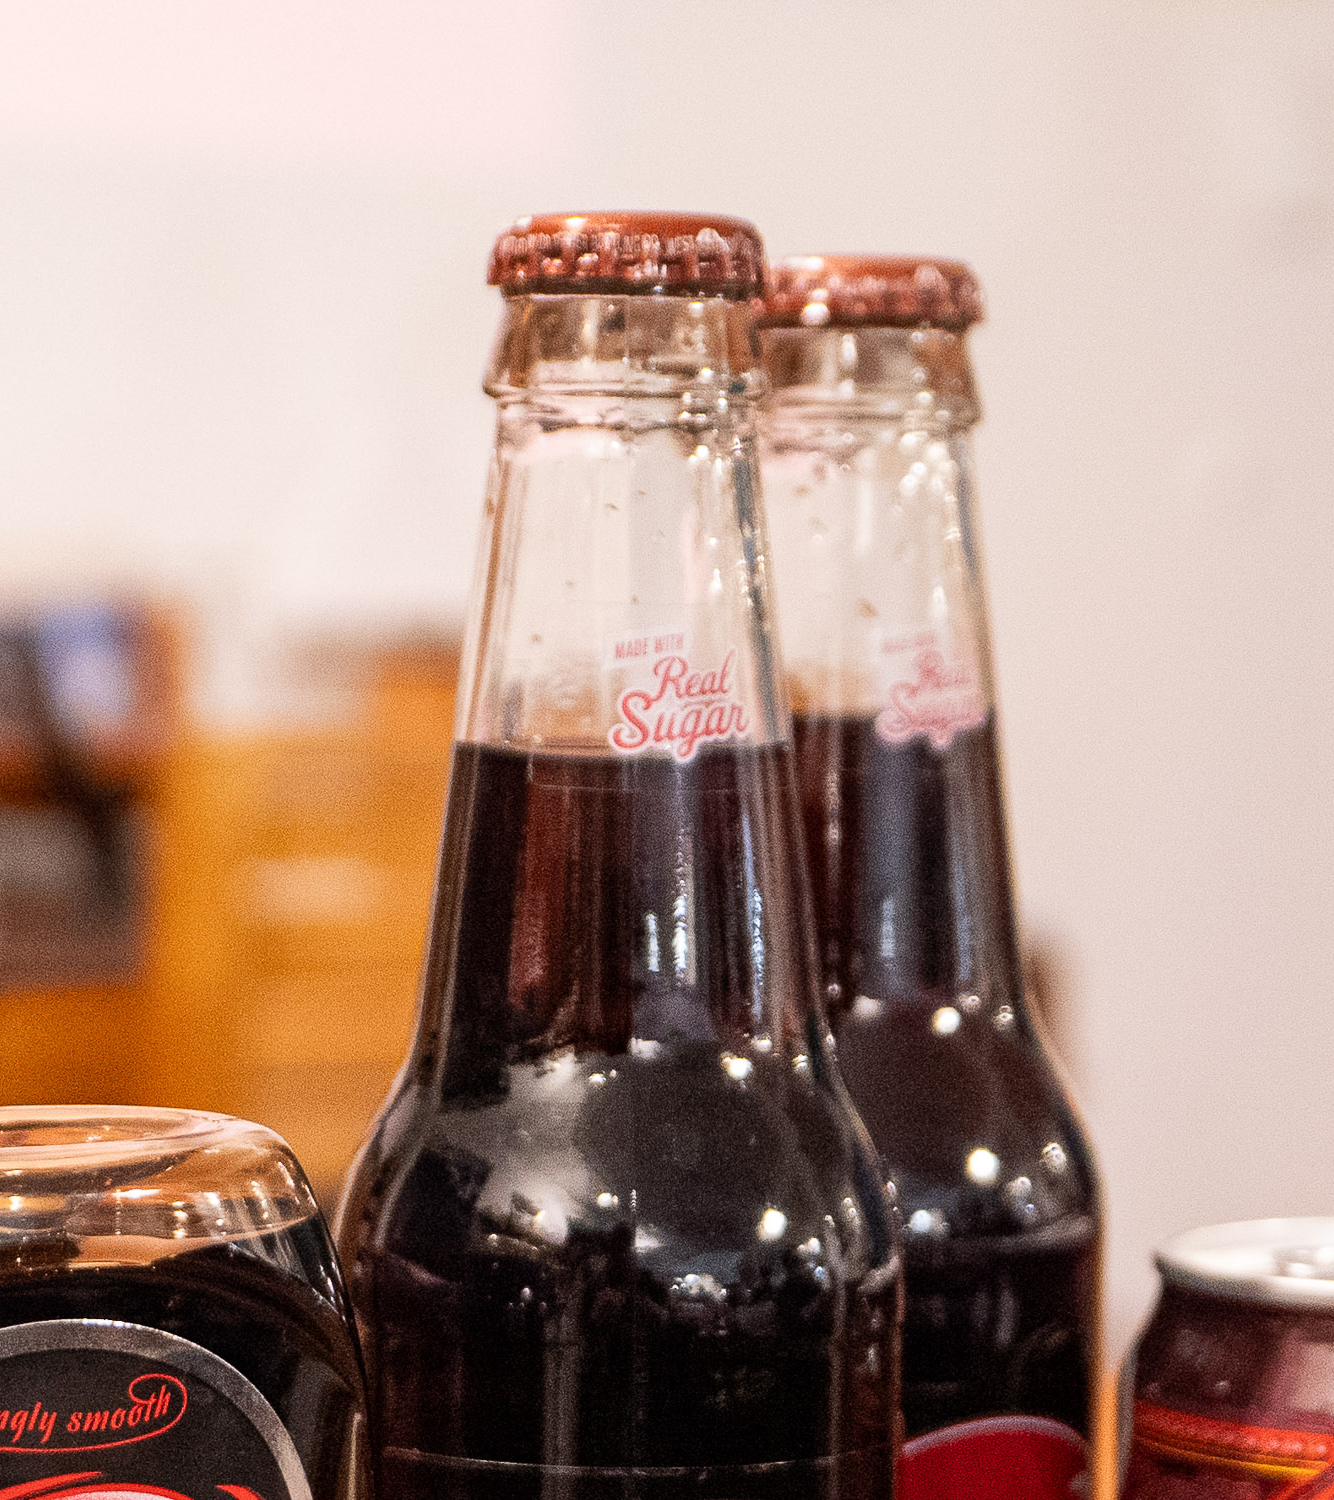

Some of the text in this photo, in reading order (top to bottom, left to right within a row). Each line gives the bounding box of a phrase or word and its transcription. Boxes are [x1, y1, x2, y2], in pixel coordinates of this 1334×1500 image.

[652, 649, 733, 701] Real
[612, 689, 749, 758] Sugar
[66, 1376, 186, 1436] smooth
